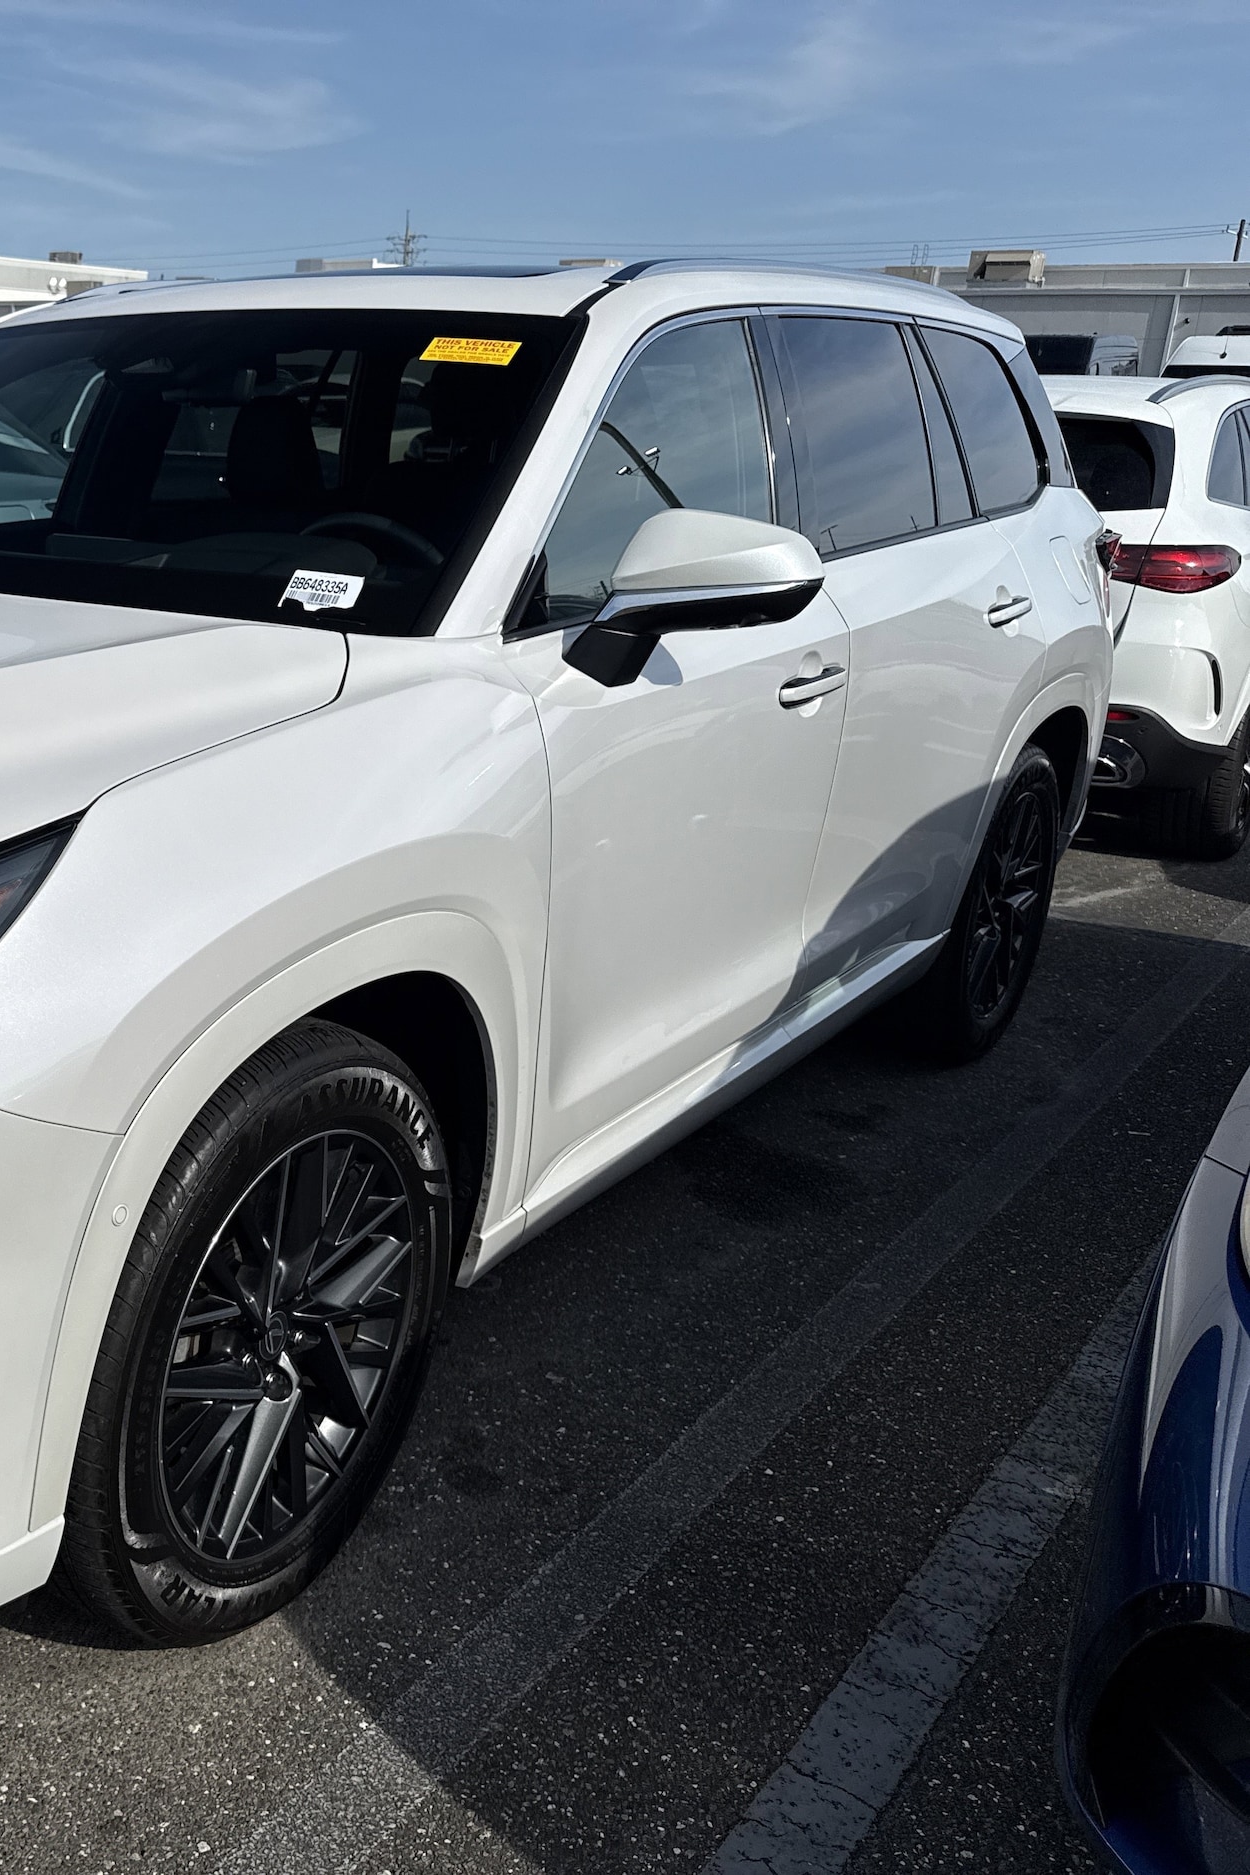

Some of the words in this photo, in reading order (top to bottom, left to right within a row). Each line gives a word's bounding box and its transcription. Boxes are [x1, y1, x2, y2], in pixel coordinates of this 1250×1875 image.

[465, 340, 516, 349] VEHICLE
[290, 577, 348, 595] BB648335A
[296, 1077, 434, 1150] ASSURANCE
